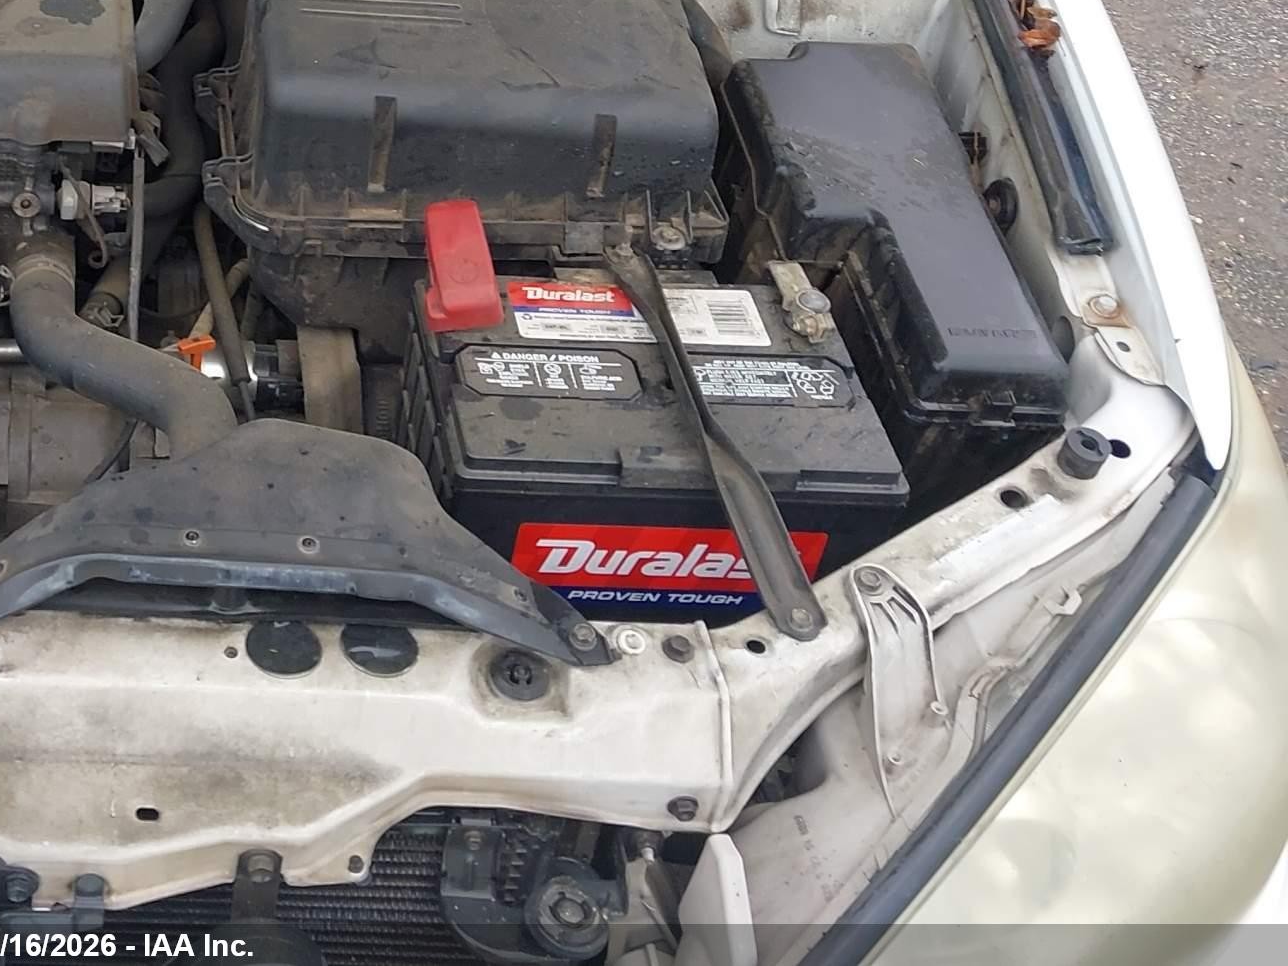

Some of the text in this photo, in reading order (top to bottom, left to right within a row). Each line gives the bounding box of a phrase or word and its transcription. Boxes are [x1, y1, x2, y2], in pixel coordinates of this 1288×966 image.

[522, 285, 615, 304] Duralast
[503, 352, 548, 362] DANGER
[558, 354, 600, 364] POISON
[535, 538, 753, 580] Duralas
[567, 589, 743, 606] PROVEN TOUGH
